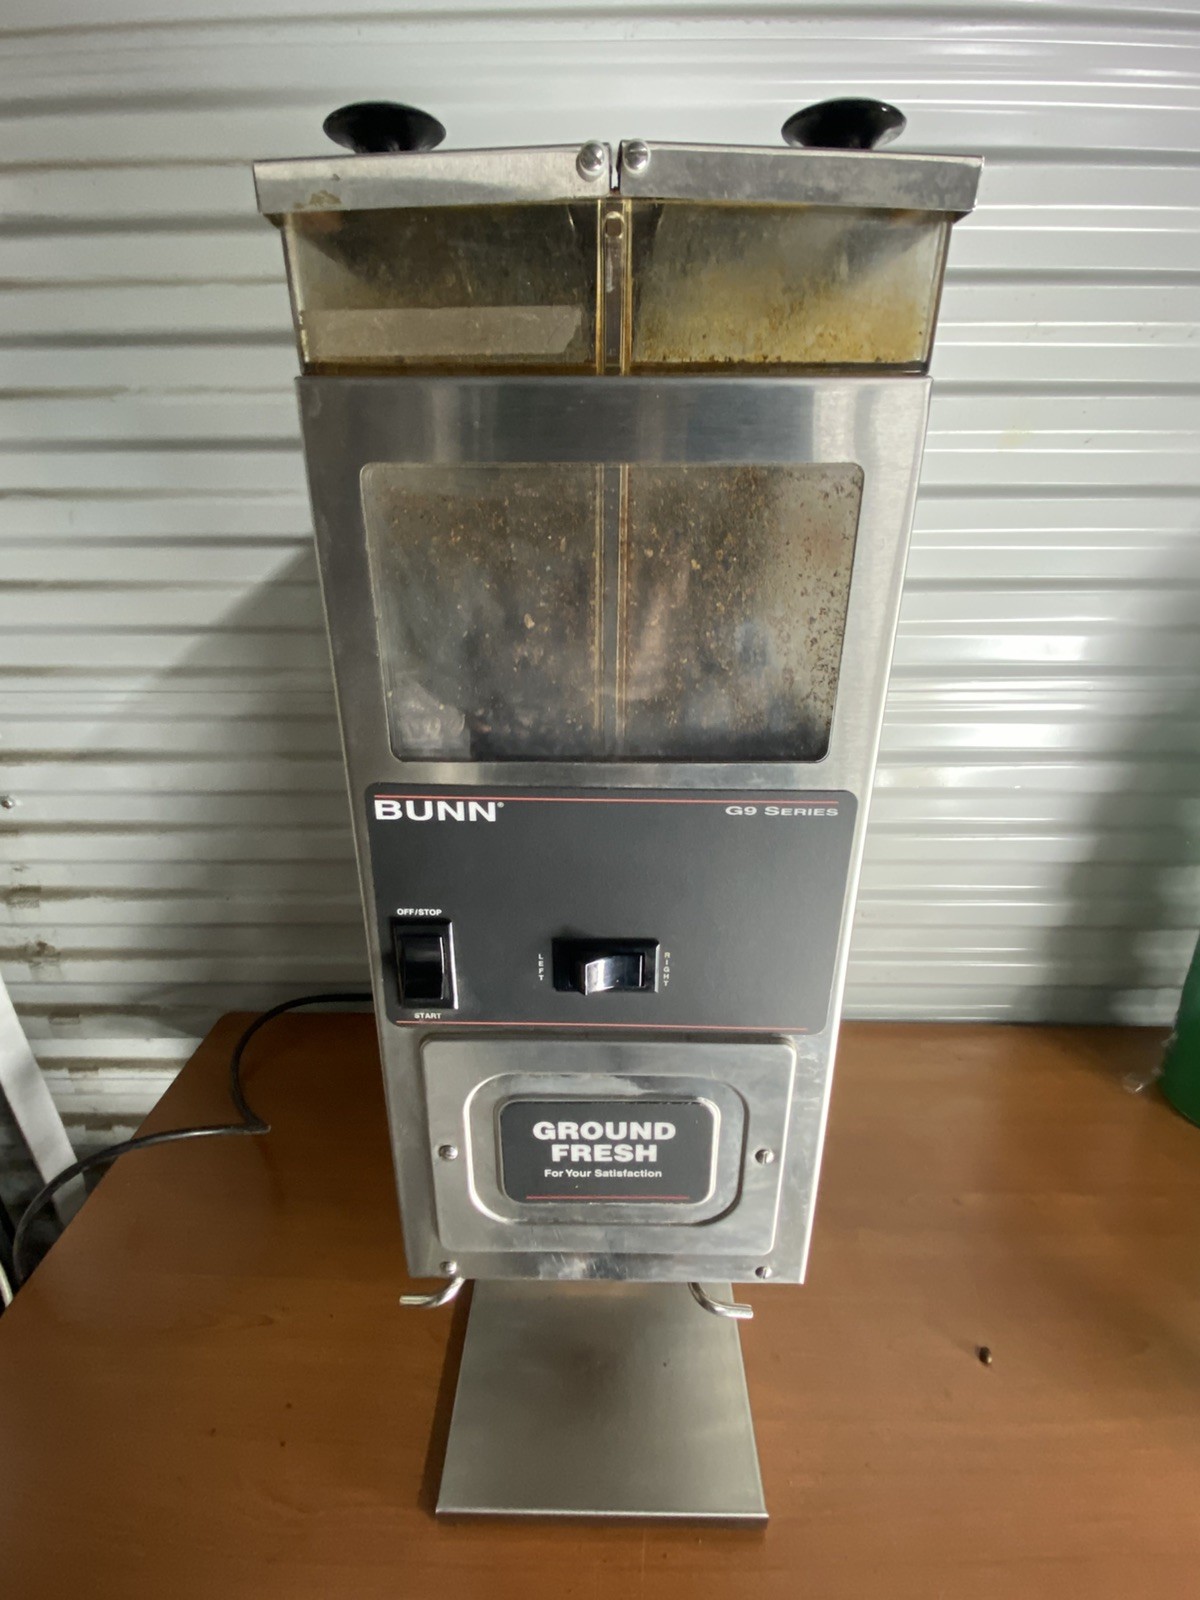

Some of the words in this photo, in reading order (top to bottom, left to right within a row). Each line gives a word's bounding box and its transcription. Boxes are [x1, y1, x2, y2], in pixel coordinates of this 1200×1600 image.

[725, 805, 758, 816] G9
[764, 805, 839, 817] SERIES
[396, 908, 443, 916] OFF/STOP
[662, 951, 671, 987] RIGHT
[532, 1121, 676, 1141] GROUND
[551, 1143, 658, 1163] FRESH
[544, 1169, 564, 1178] For
[565, 1169, 592, 1178] Your
[594, 1169, 663, 1178] Satisfaction
